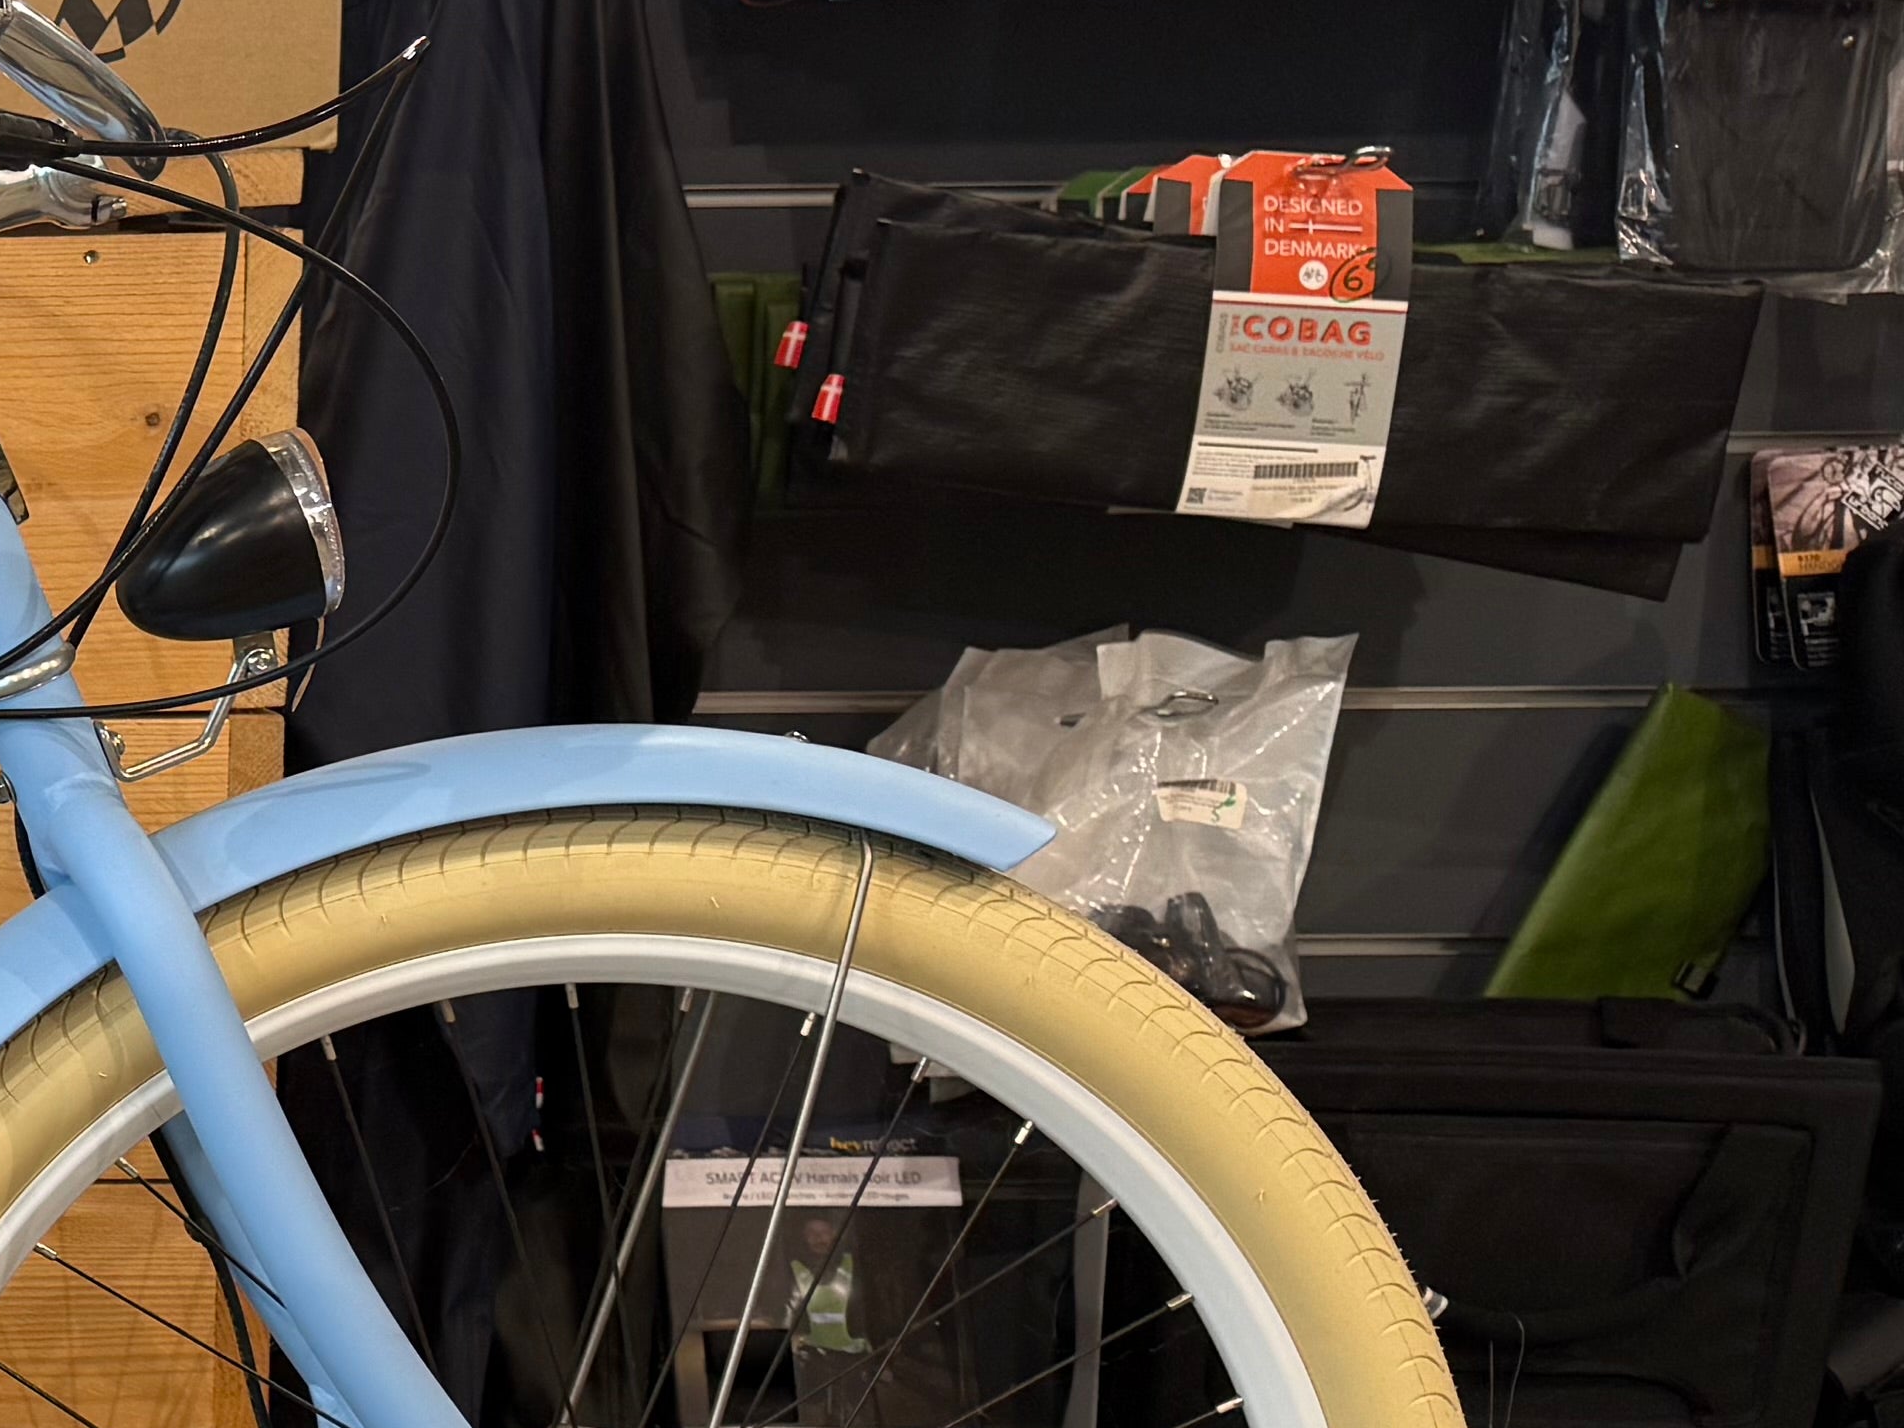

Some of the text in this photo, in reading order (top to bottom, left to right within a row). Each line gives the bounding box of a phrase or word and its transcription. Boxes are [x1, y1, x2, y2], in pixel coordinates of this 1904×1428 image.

[1263, 195, 1363, 217] DESIGNED
[1264, 218, 1285, 233] IN
[1243, 314, 1373, 346] COBAG
[806, 1171, 859, 1185] Harnais
[894, 1170, 922, 1184] LED
